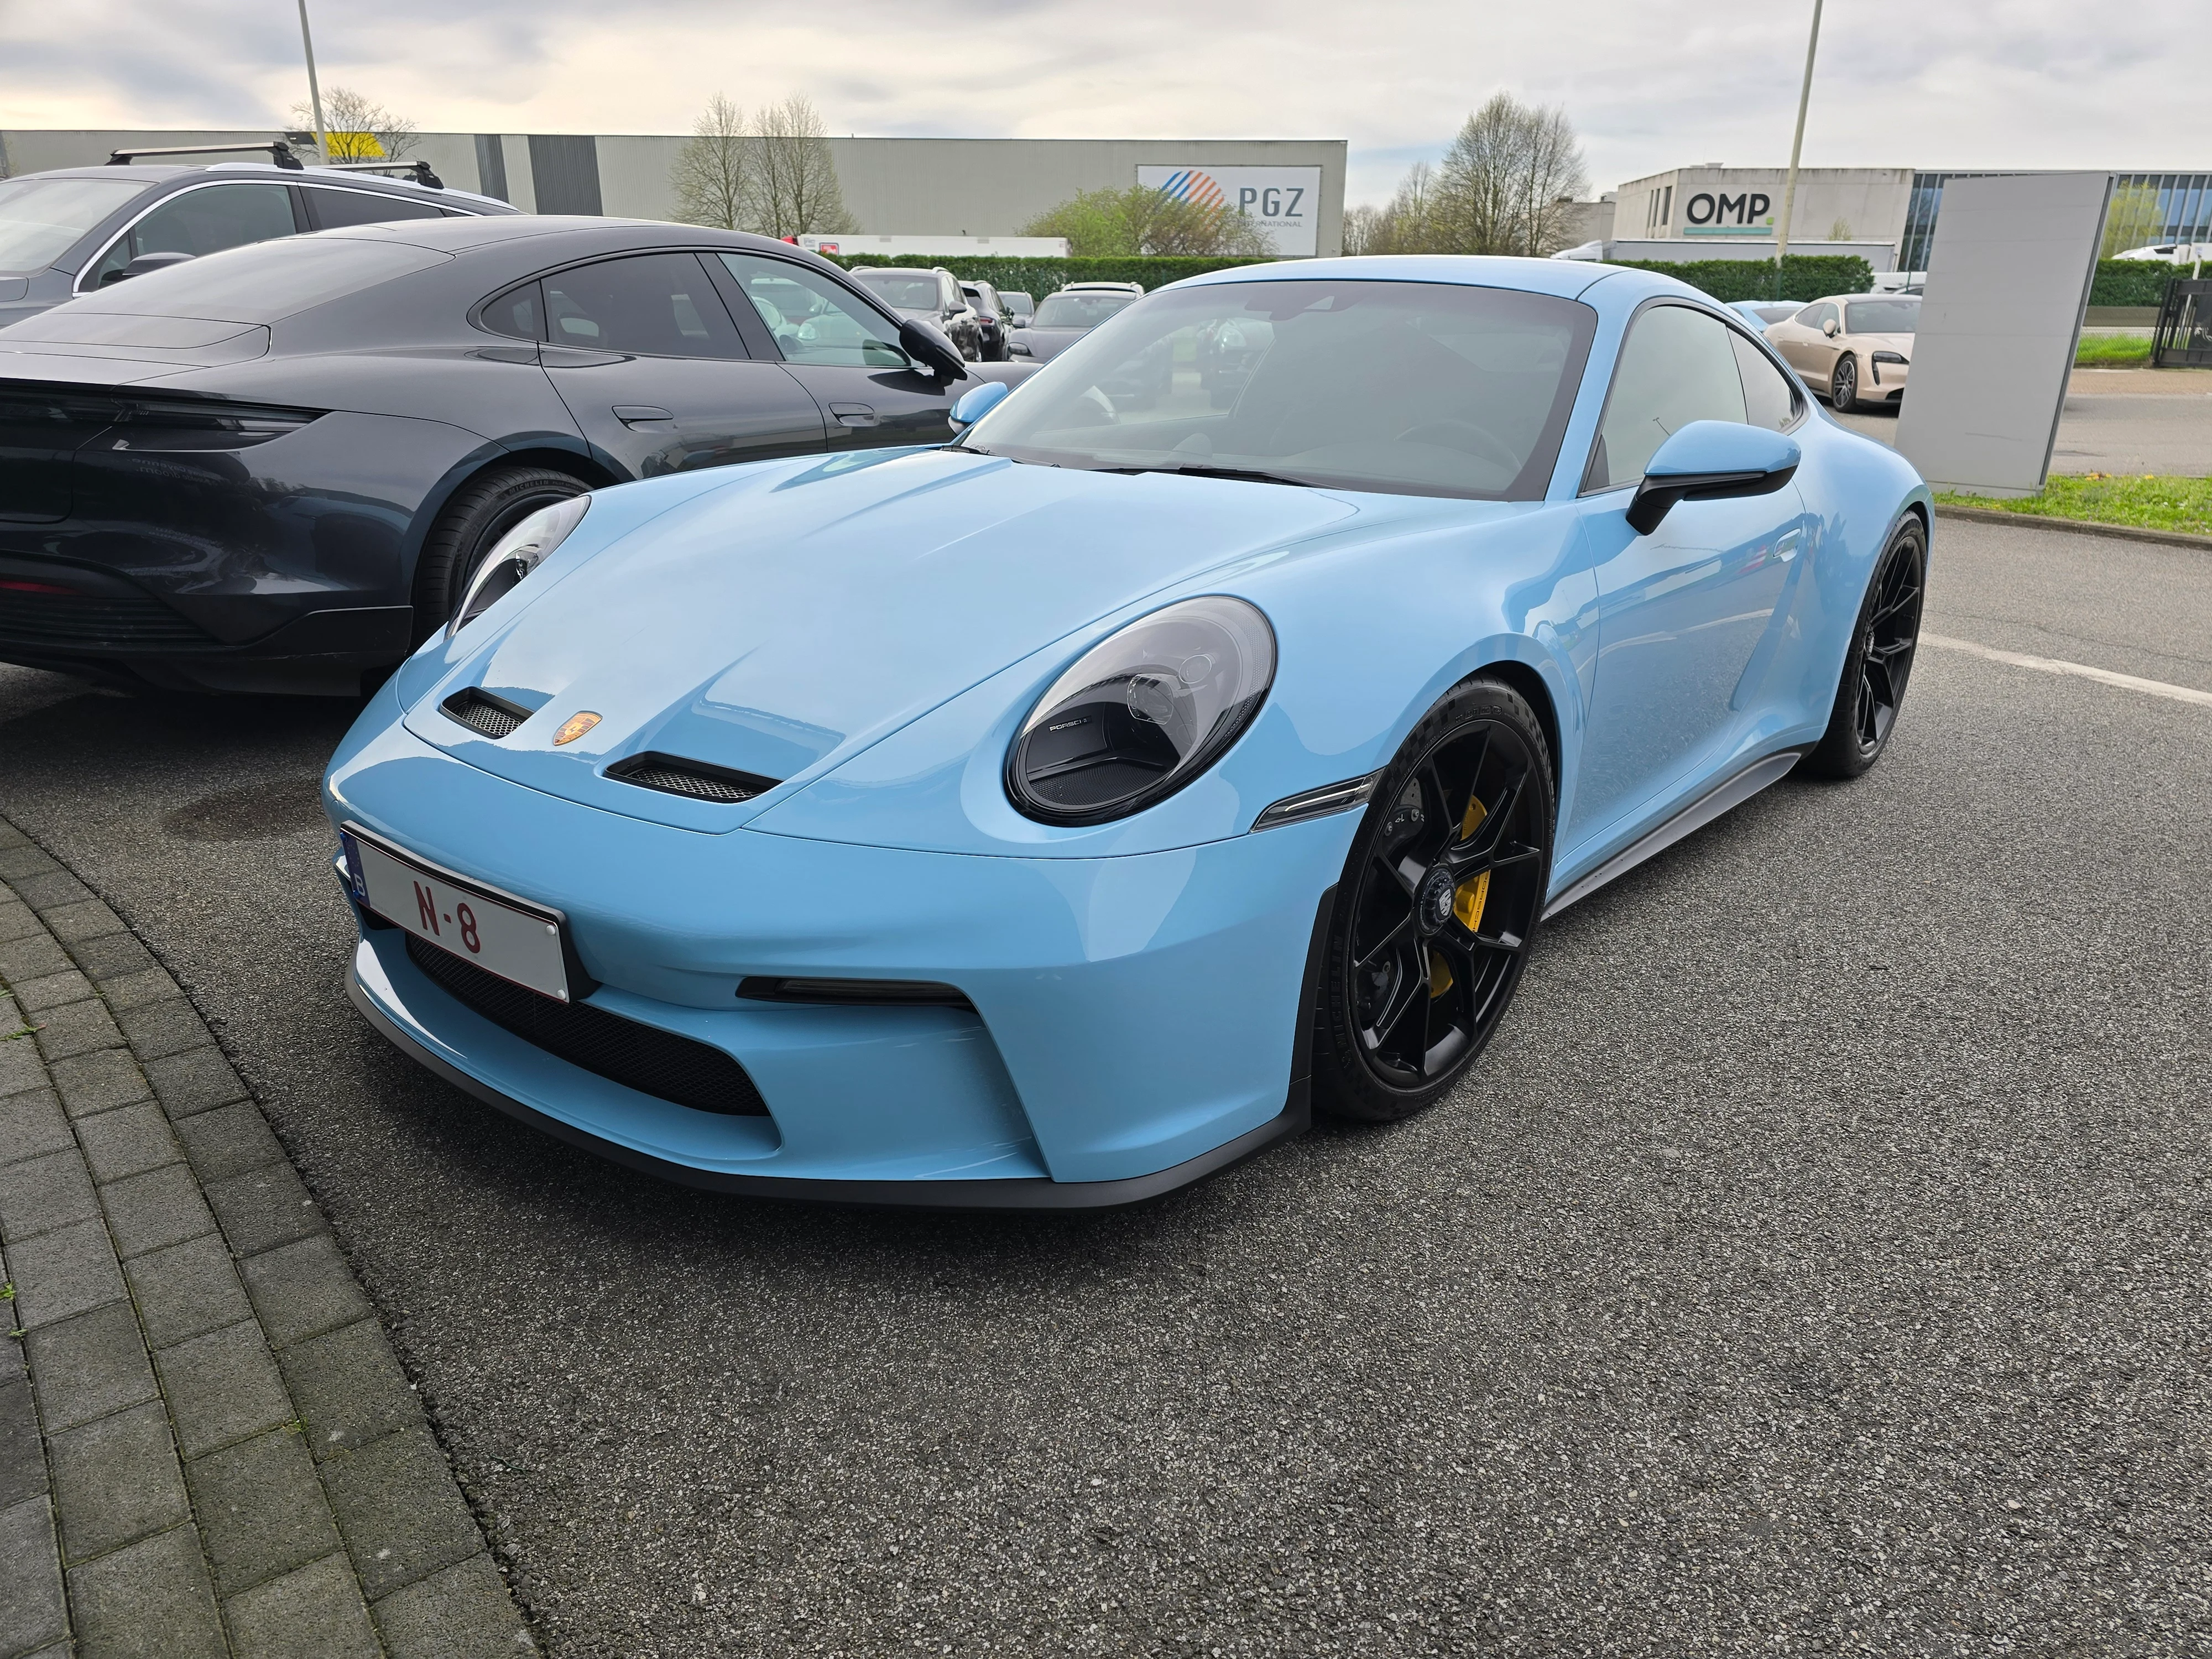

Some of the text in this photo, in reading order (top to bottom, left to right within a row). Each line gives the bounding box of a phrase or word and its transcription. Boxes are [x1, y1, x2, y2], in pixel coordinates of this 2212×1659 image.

[1239, 187, 1305, 217] PGZ
[509, 479, 549, 494] MICHELIN
[353, 873, 365, 896] B
[414, 880, 481, 953] N-8
